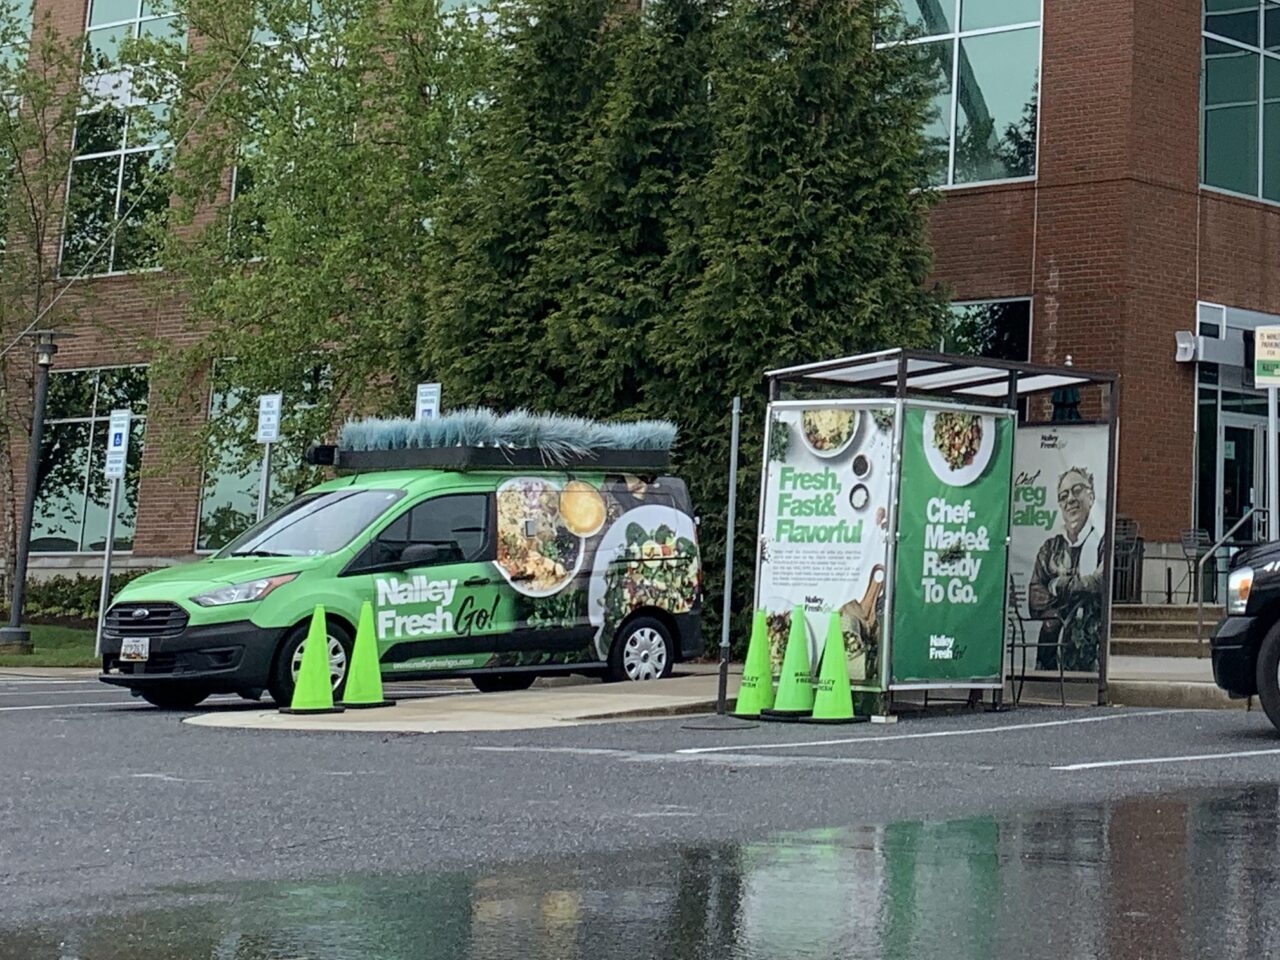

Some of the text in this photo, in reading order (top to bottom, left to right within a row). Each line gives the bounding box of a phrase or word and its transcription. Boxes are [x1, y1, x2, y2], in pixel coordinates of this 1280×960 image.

[1041, 434, 1059, 443] Nalley
[779, 466, 842, 495] Fresh,
[1014, 469, 1041, 486] Chef
[1013, 486, 1047, 508] reg
[926, 497, 976, 524] Chef-
[1013, 504, 1058, 531] alley
[775, 519, 864, 544] Flavorful
[922, 551, 982, 582] Ready
[376, 575, 458, 607] Nalley
[805, 596, 824, 605] Nalley
[921, 578, 978, 604] To Go.
[378, 593, 501, 639] Fresh Go!
[804, 604, 823, 612] Fresh
[929, 634, 955, 648] Nalley
[929, 646, 954, 660] Fresh
